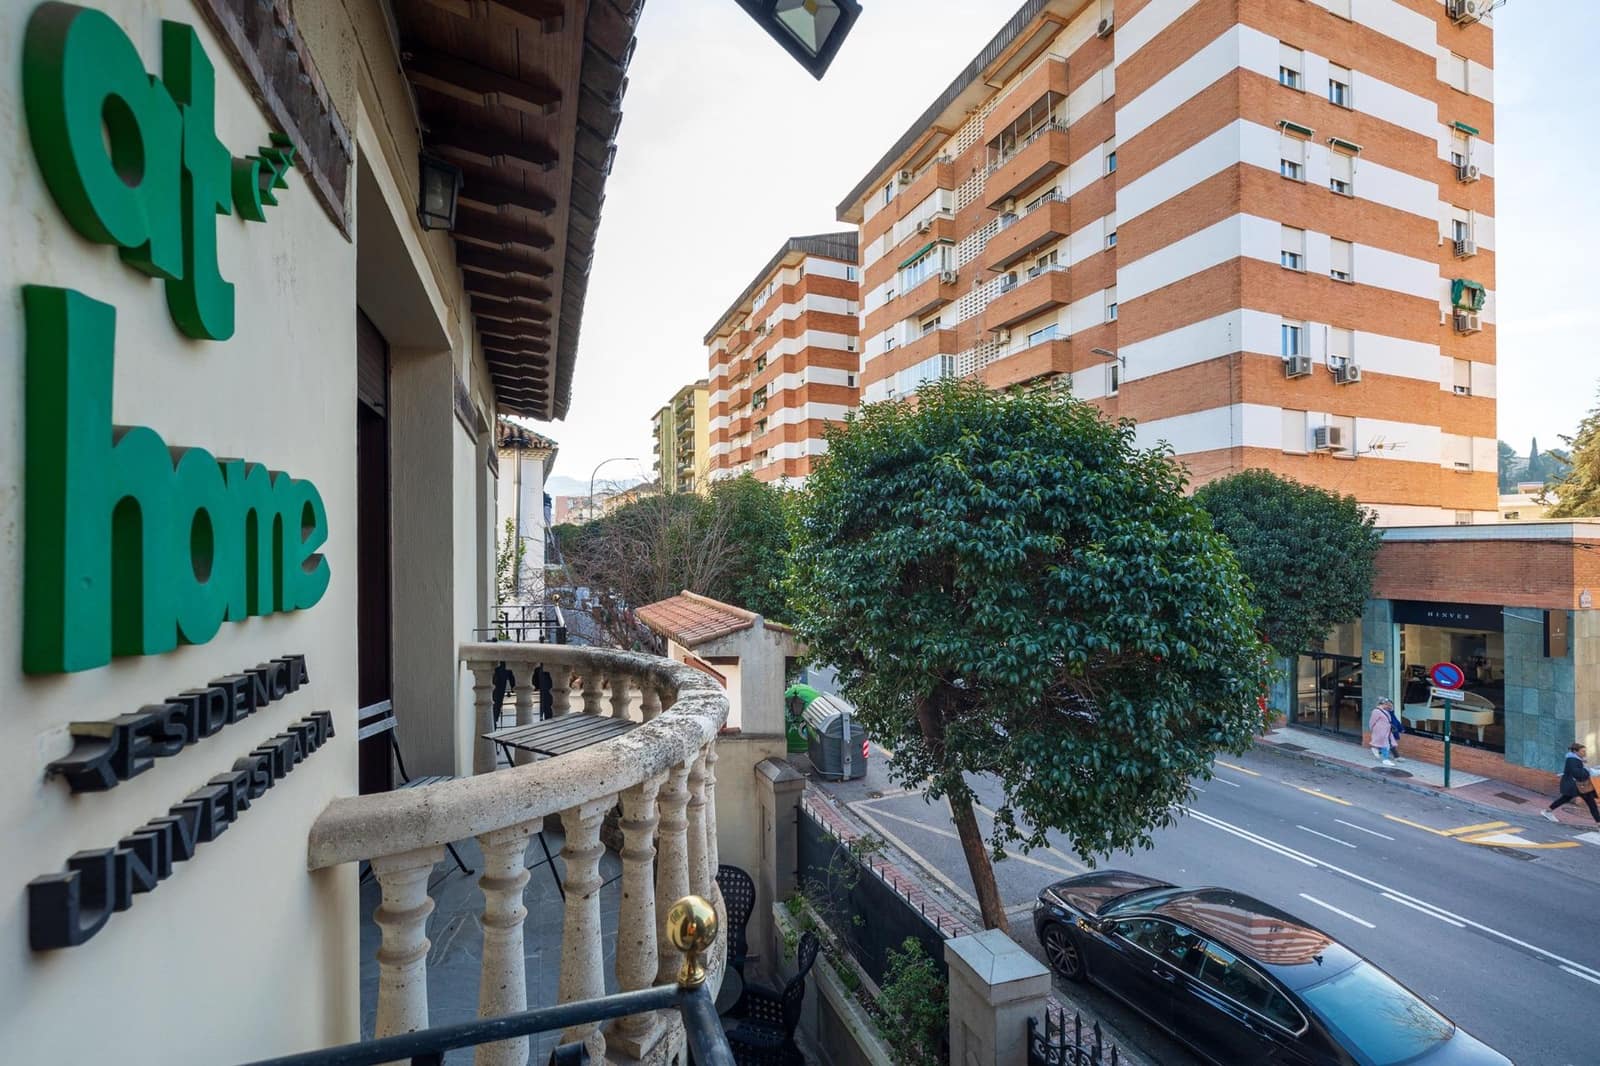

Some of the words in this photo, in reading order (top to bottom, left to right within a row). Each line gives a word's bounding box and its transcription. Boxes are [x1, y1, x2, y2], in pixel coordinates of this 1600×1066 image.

[23, 285, 331, 675] home
[27, 710, 336, 950] UNIVERSITARIA
[46, 653, 310, 793] RESIDENCIA
